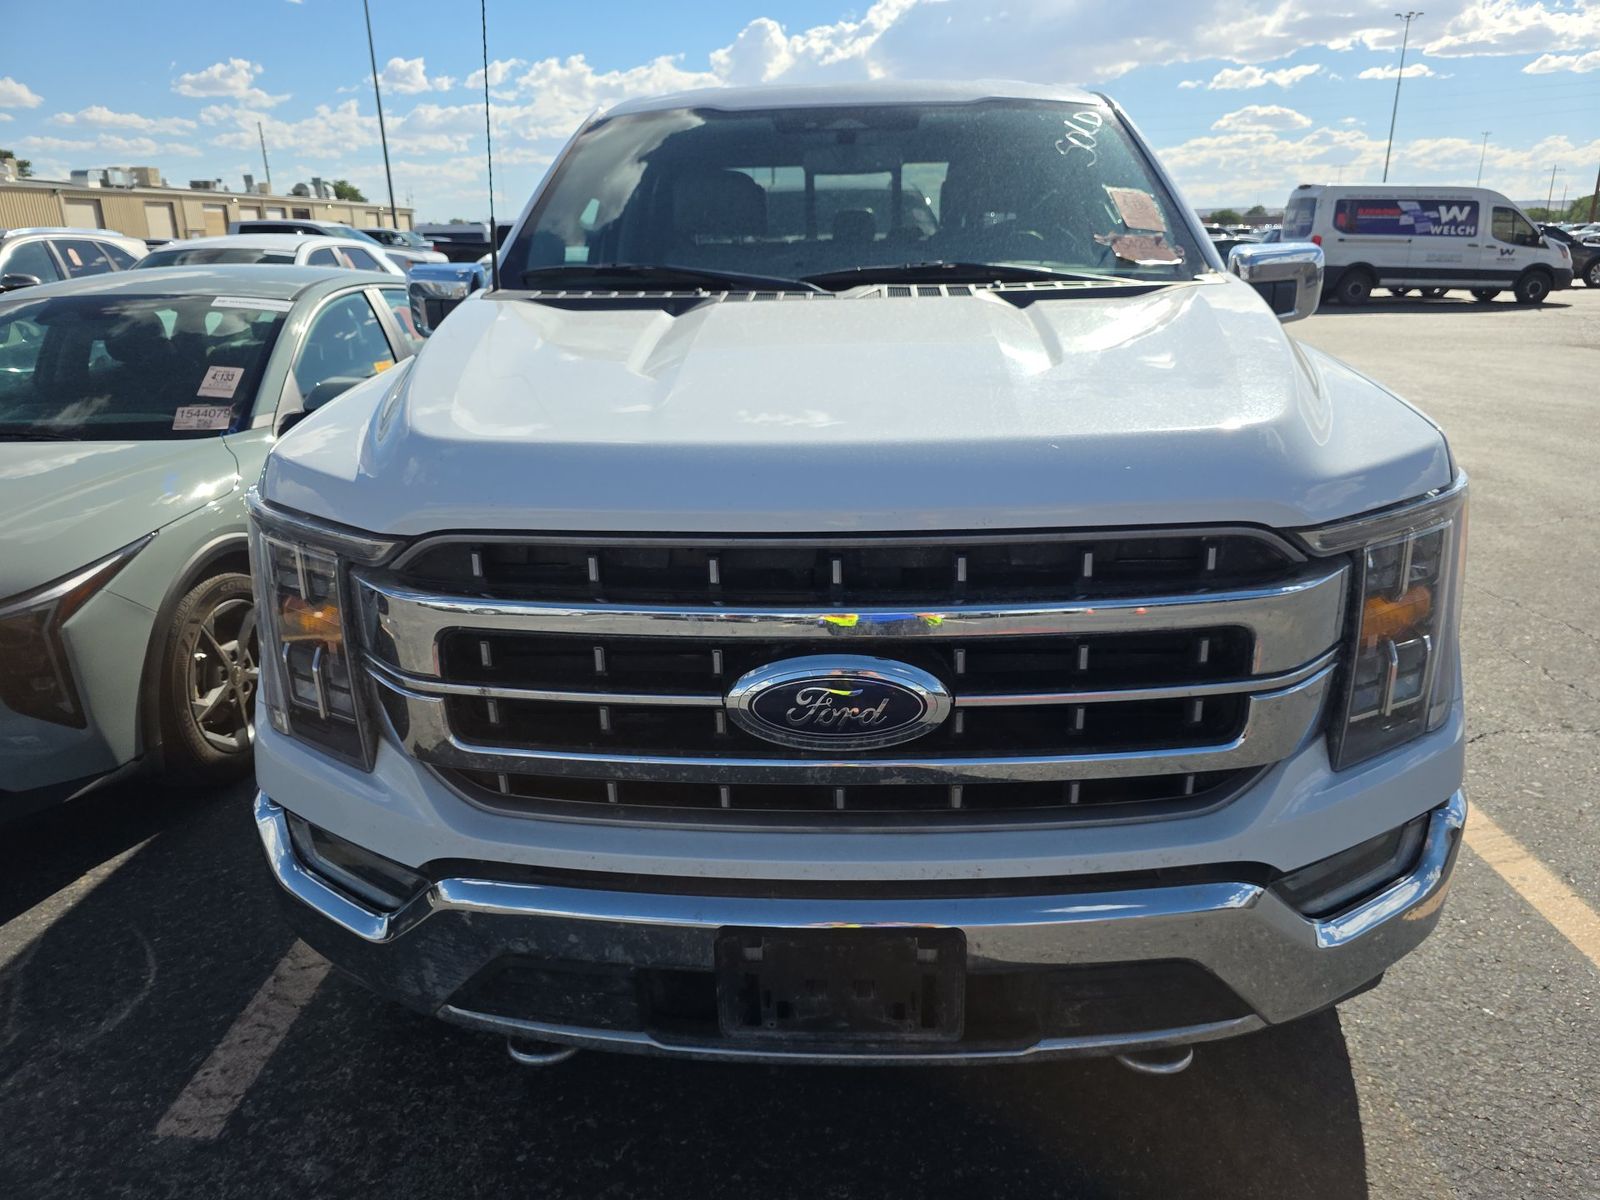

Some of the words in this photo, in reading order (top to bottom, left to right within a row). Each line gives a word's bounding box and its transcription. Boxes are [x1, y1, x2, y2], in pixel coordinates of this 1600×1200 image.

[1438, 205, 1471, 224] W
[1430, 224, 1476, 236] WELCH
[180, 408, 231, 418] 1544079
[786, 687, 889, 727] Ford
